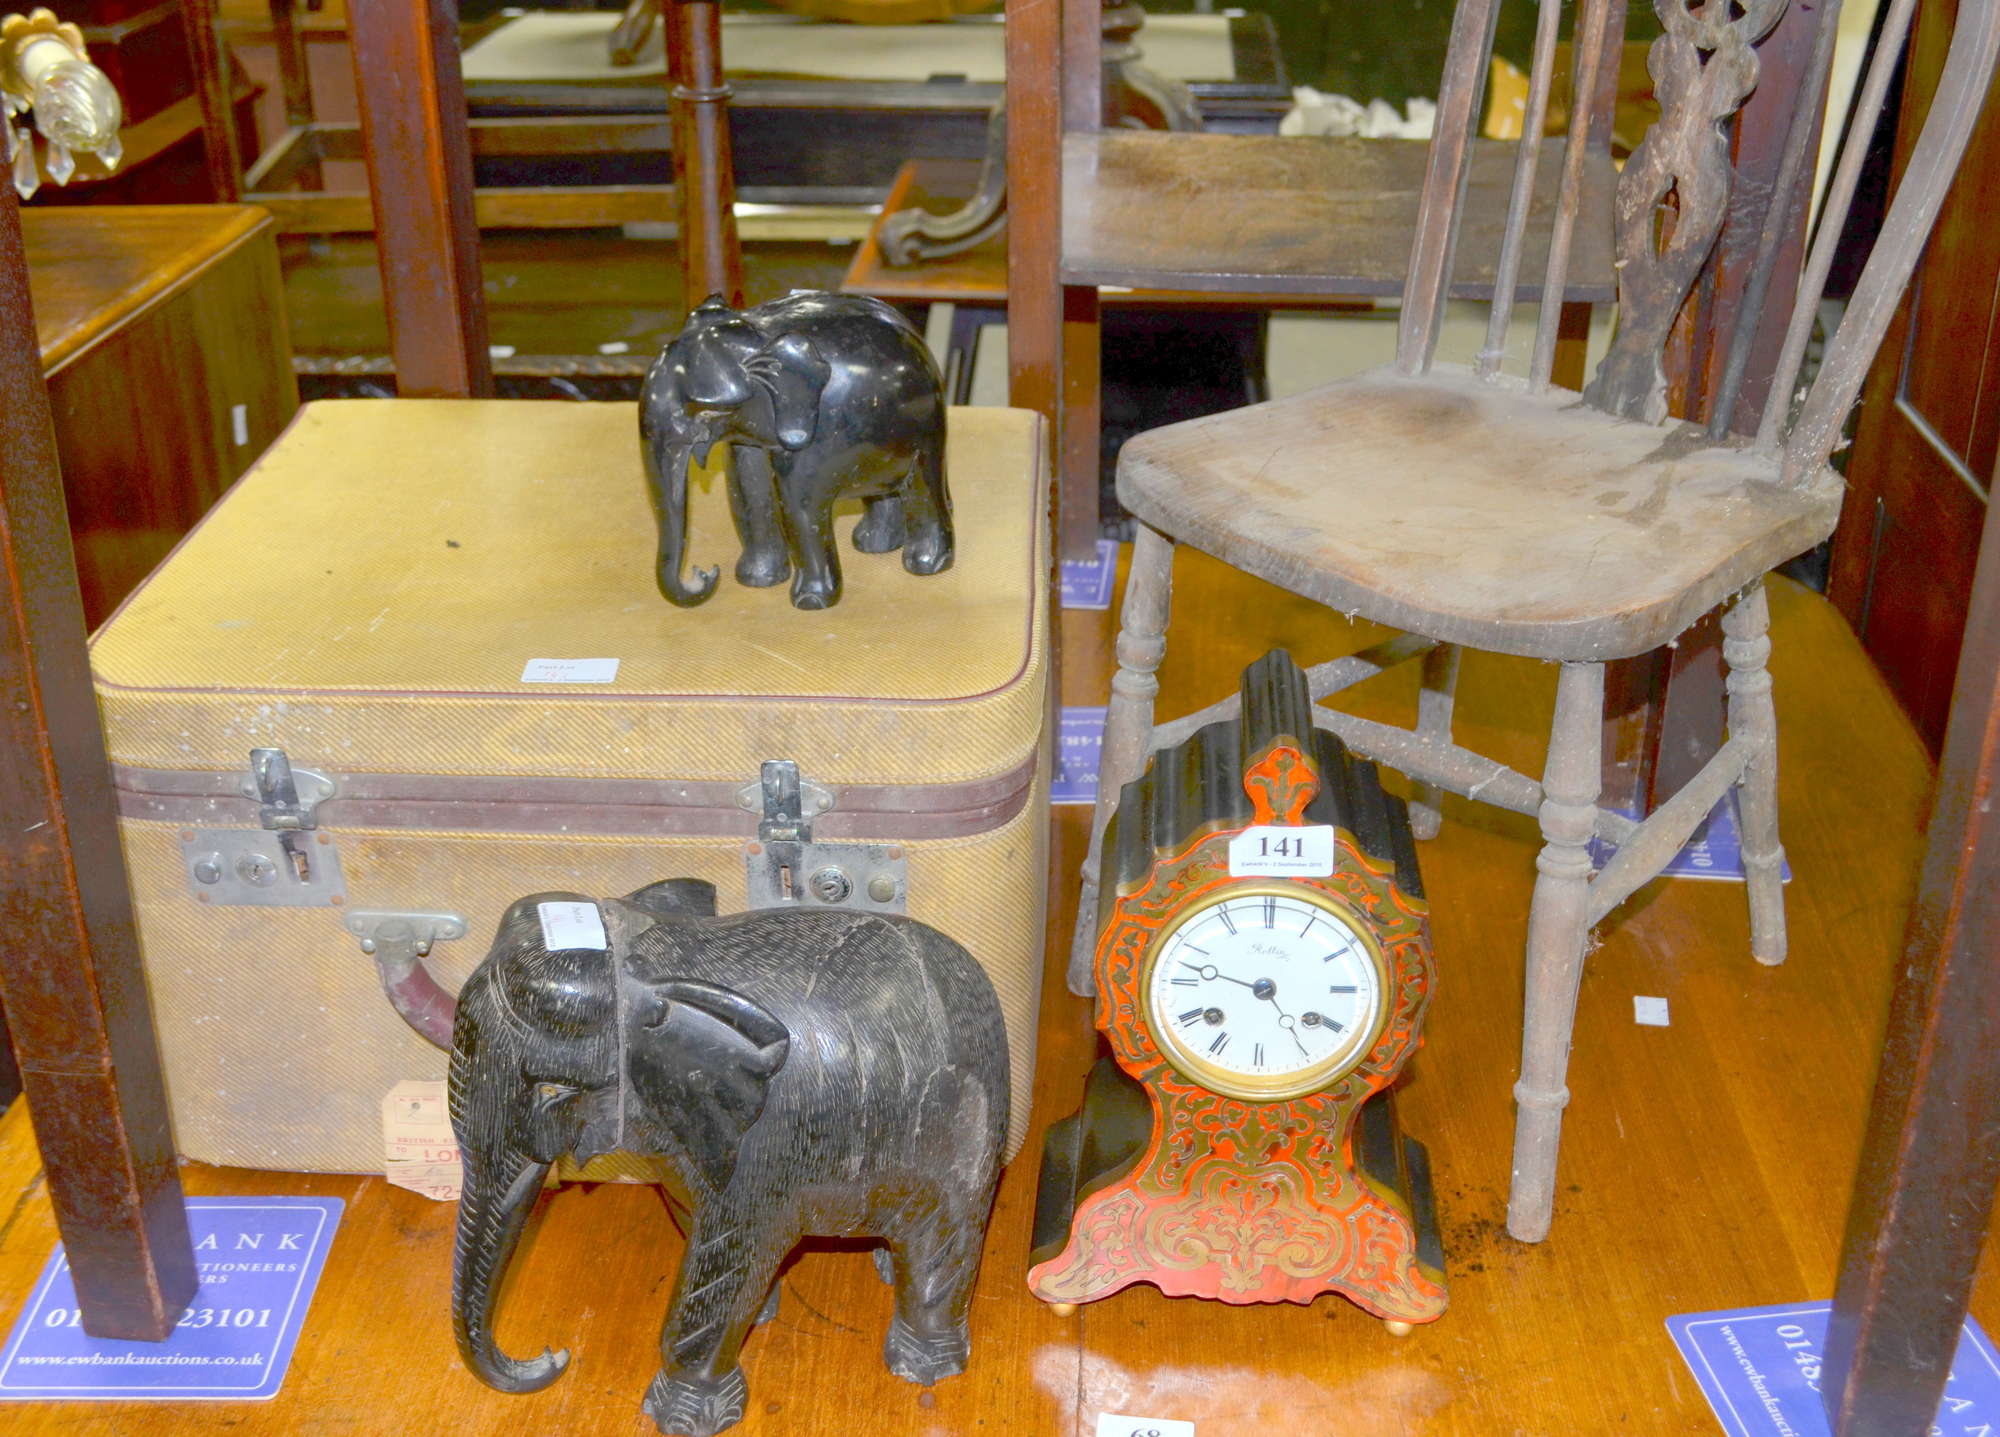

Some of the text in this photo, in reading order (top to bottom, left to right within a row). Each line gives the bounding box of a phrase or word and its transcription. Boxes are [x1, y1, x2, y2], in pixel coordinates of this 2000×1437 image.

[1258, 836, 1304, 858] 141
[176, 1308, 272, 1329] 23101
[18, 1352, 265, 1366] www.ewbankauctions.co.uk
[1776, 1324, 1823, 1393] 0148
